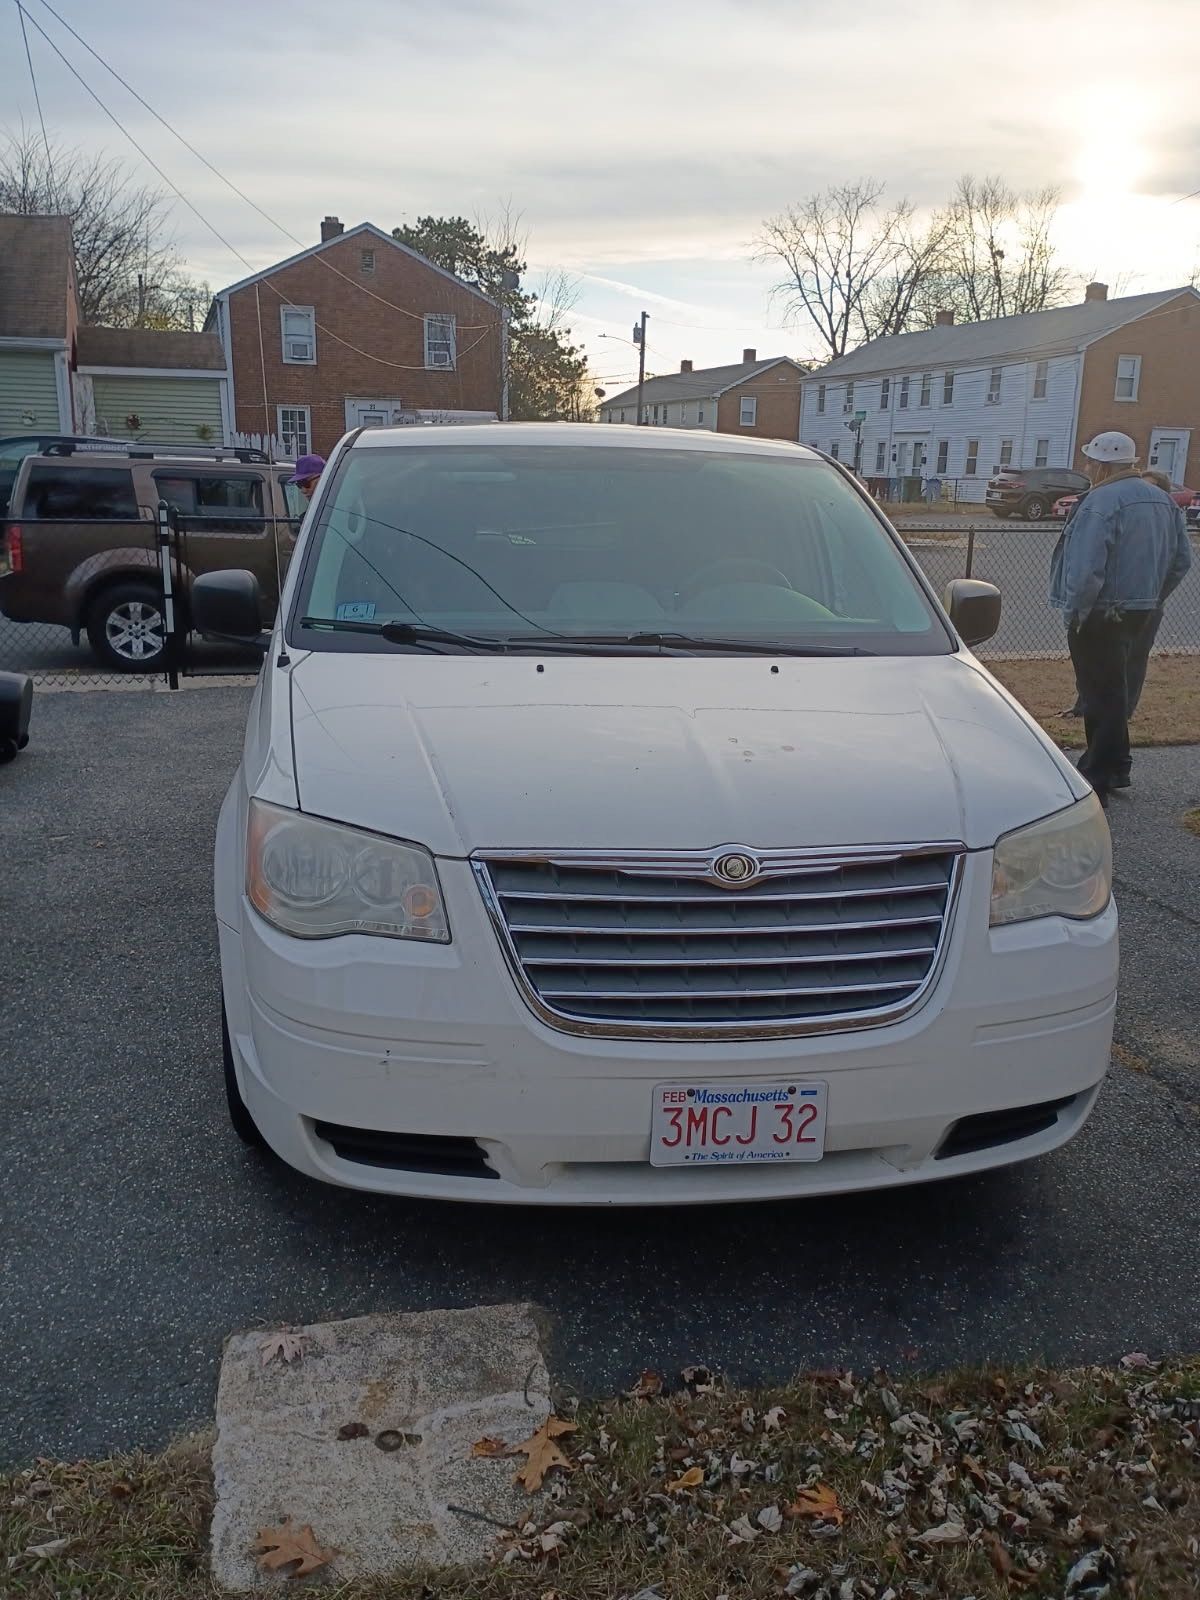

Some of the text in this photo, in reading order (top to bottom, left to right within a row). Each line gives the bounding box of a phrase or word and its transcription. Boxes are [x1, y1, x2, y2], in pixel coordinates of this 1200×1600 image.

[663, 1092, 687, 1102] FEB
[694, 1089, 788, 1103] Massachusetts
[661, 1103, 817, 1147] 3MCJ 32
[692, 1151, 784, 1161] The Spirit of America
